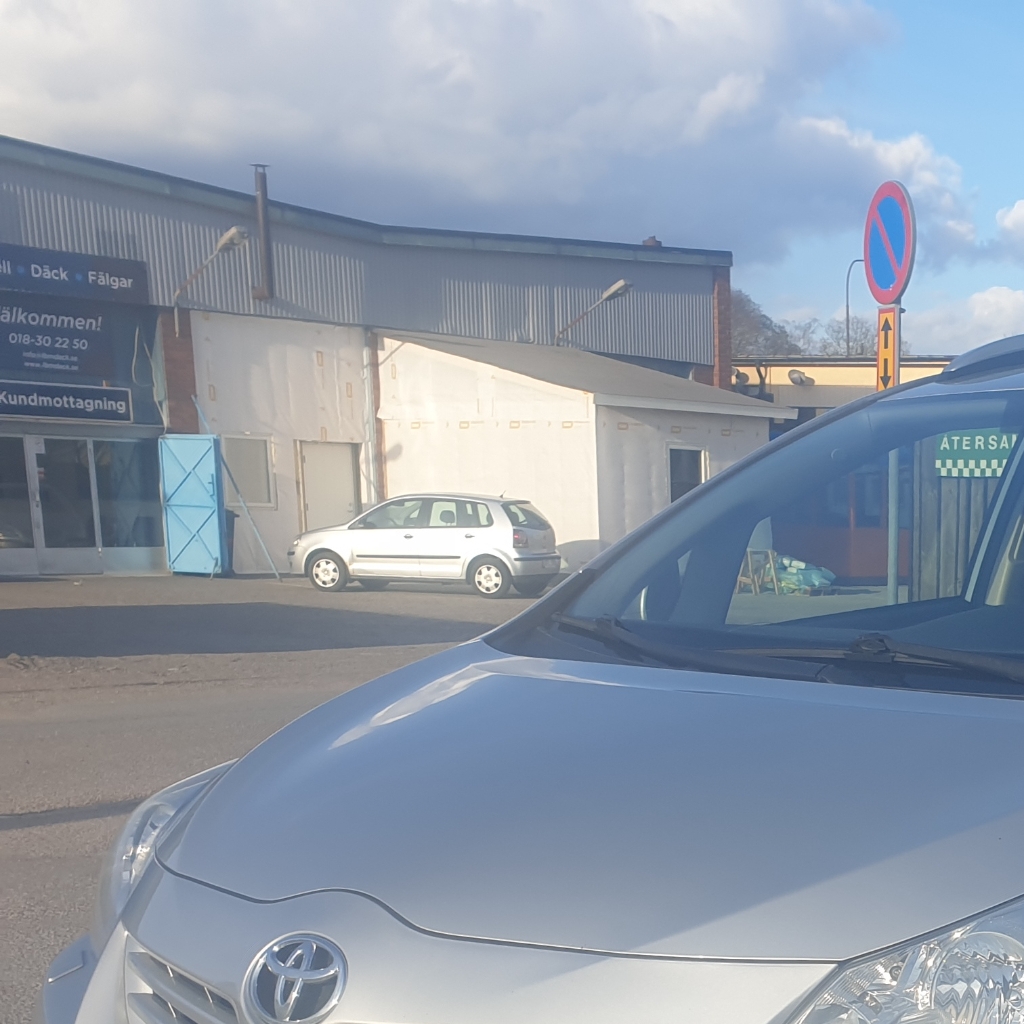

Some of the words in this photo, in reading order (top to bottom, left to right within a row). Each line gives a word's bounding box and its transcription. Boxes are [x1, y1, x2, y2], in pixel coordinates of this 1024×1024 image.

[0, 260, 12, 275] ll
[30, 263, 69, 281] Däck
[87, 270, 134, 289] Fälgar
[0, 305, 103, 331] älkommen!
[8, 332, 52, 347] 018-30
[54, 336, 70, 349] 22
[72, 338, 89, 350] 50
[0, 391, 126, 413] Kundmottagning
